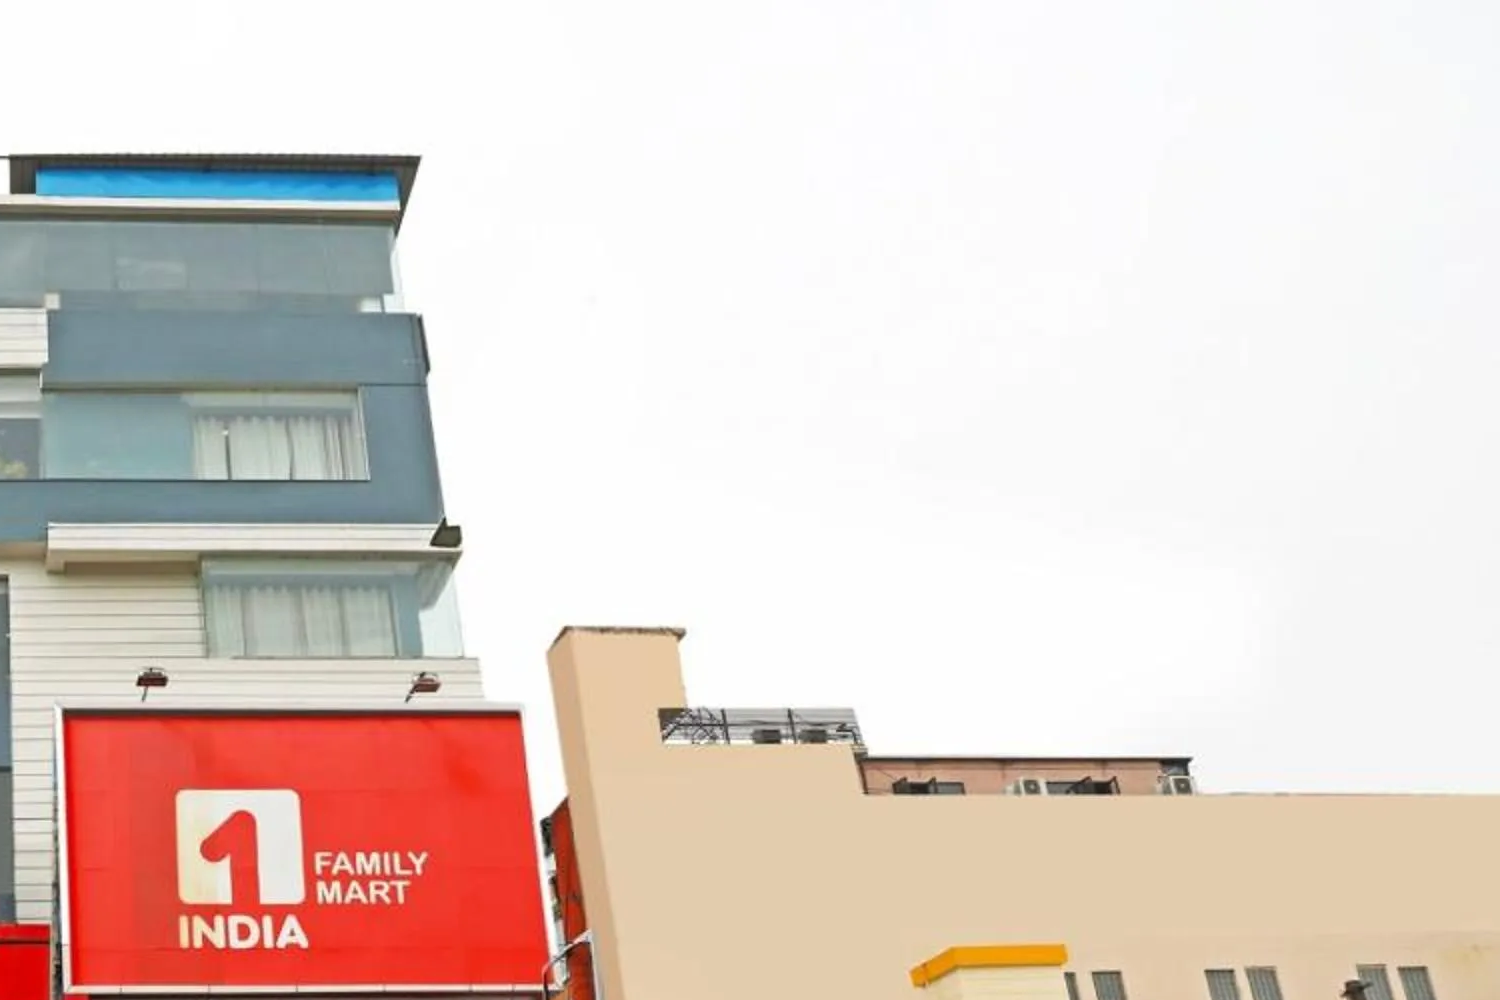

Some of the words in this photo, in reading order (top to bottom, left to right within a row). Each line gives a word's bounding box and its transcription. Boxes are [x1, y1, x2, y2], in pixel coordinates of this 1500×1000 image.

[314, 851, 429, 876] FAMILY
[316, 880, 411, 905] MART
[179, 914, 309, 949] INDIA
